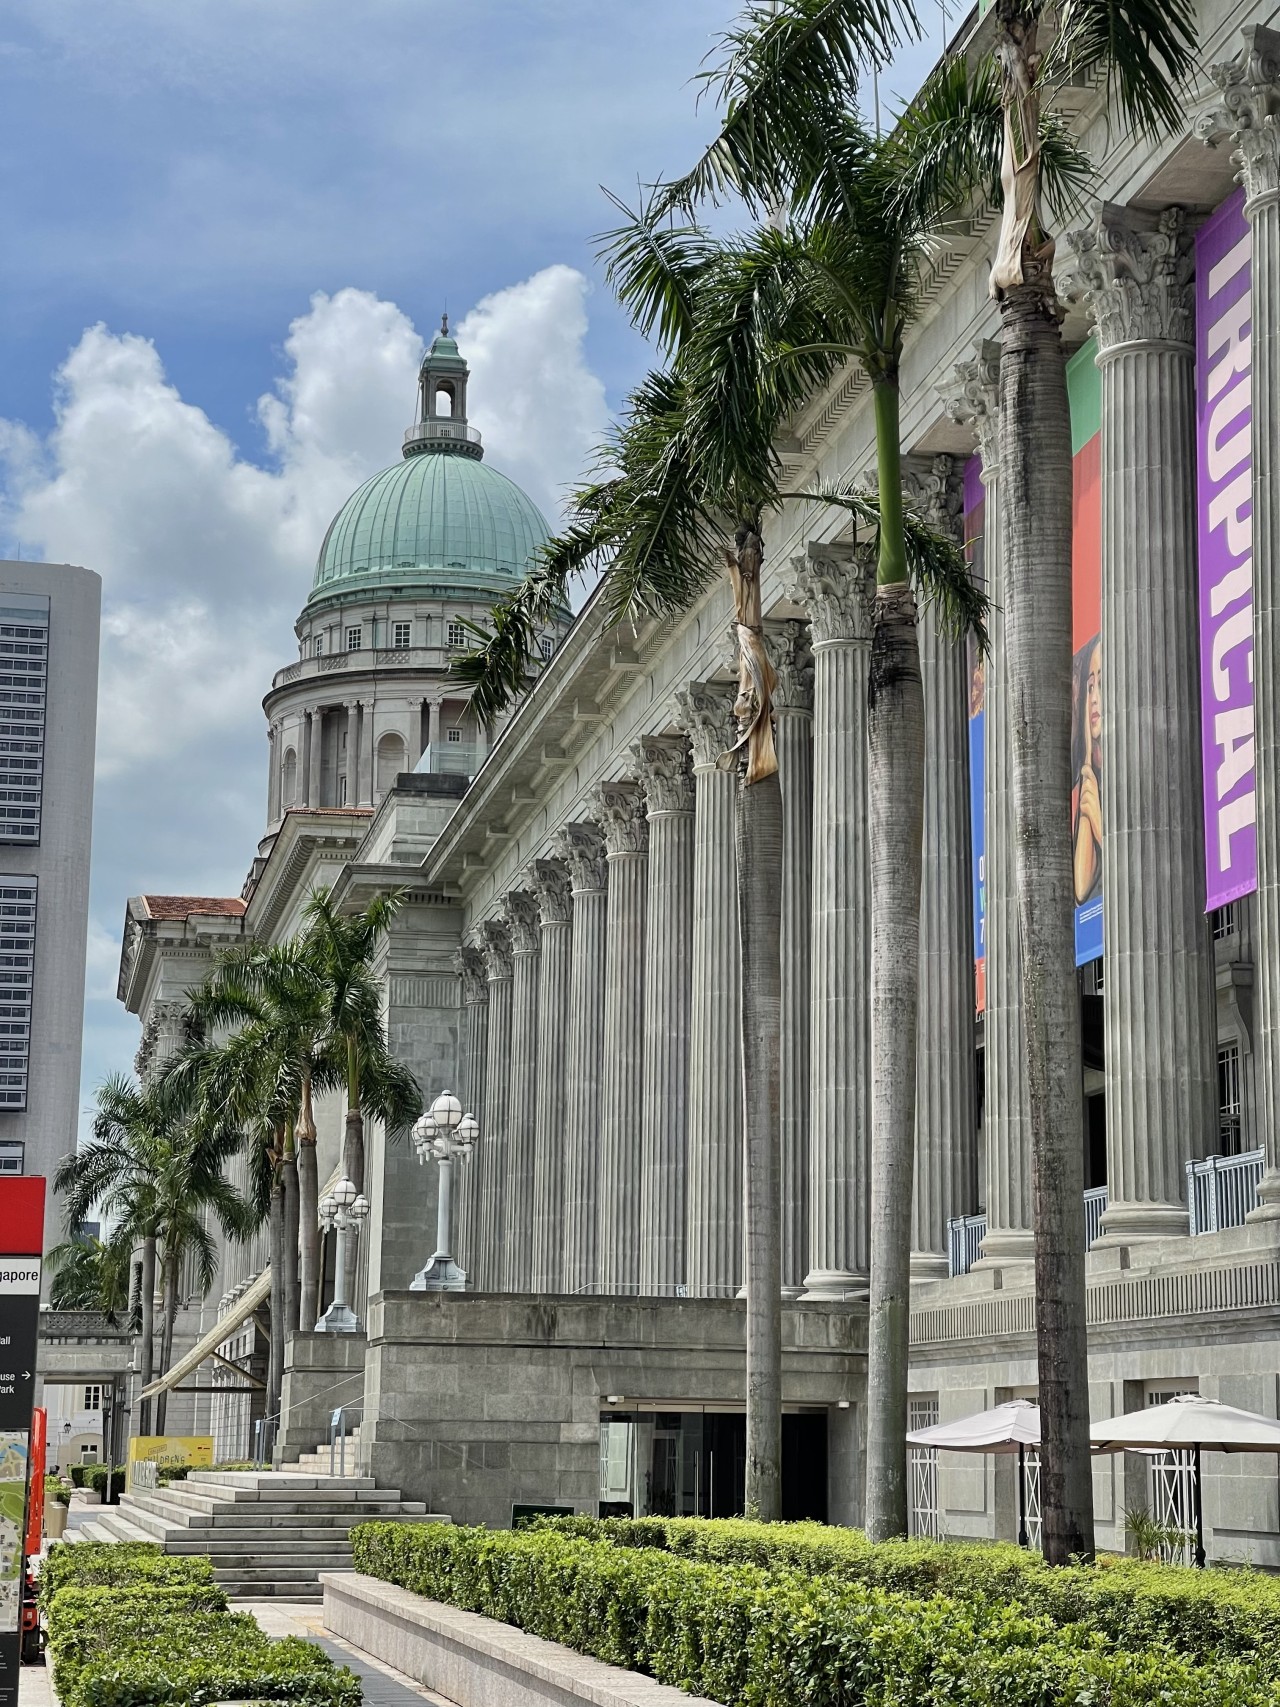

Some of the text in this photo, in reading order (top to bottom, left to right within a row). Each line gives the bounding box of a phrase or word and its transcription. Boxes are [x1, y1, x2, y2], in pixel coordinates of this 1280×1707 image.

[0, 1271, 38, 1283] apore
[0, 1336, 11, 1345] all
[0, 1373, 16, 1381] use
